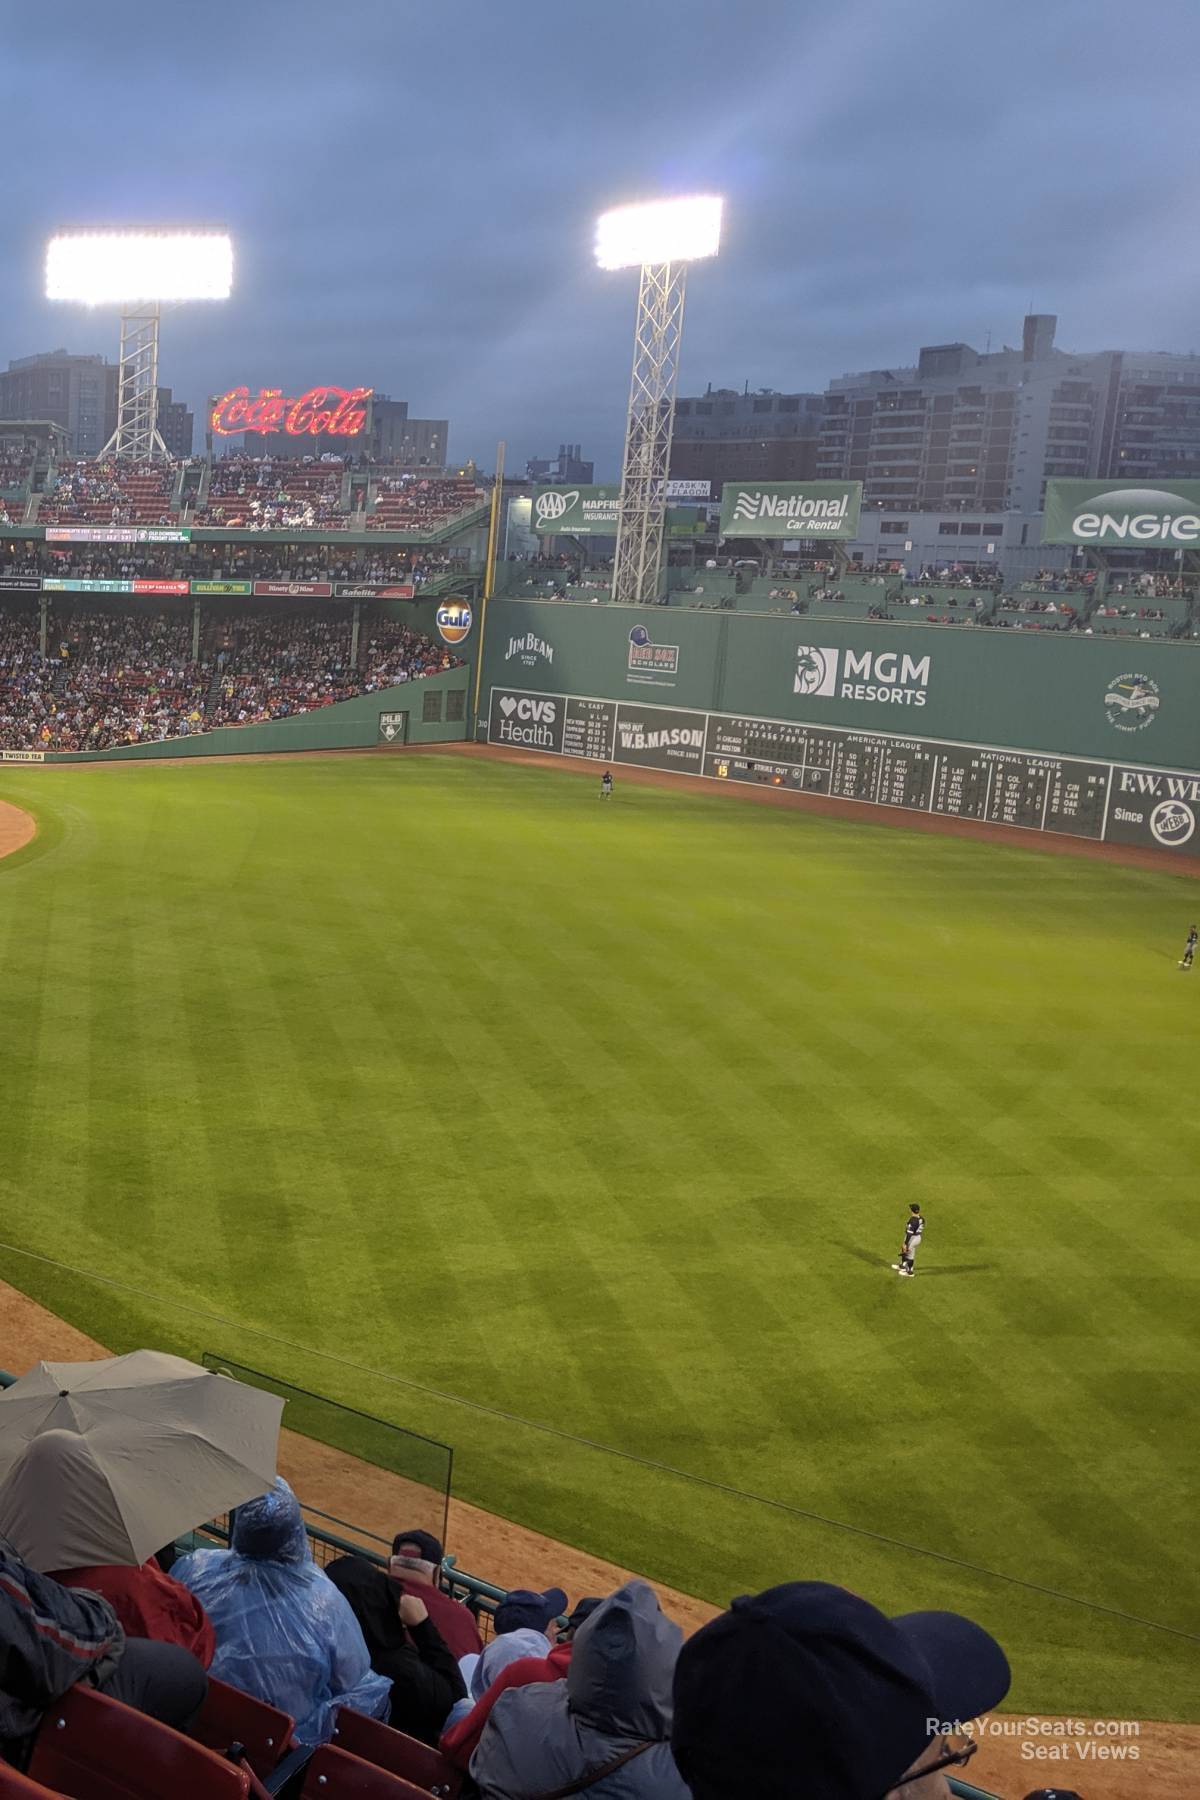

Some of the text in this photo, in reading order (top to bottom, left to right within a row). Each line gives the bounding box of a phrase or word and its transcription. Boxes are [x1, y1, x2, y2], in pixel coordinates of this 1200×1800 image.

[211, 384, 375, 436] Coca-Cola
[540, 493, 564, 517] AAA
[786, 519, 841, 530] Car Rental
[342, 587, 376, 596] Safelite
[438, 609, 471, 628] Gulf
[505, 632, 553, 664] JIM BEAM
[632, 659, 675, 668] SCHOLARS
[843, 649, 932, 686] MGM
[841, 683, 927, 707] RESORTS
[517, 698, 556, 723] CVS
[499, 719, 554, 746] Health
[731, 720, 808, 736] FENWAY PARK
[847, 735, 922, 751] AMERICAN LEAGUE
[667, 749, 684, 757] SINCE
[980, 752, 1062, 769] NATIONAL LEAGUE
[754, 764, 773, 772] STRIKE
[775, 765, 788, 774] OUT
[893, 781, 905, 789] MIN
[896, 774, 904, 782] TB
[1007, 775, 1021, 783] COL
[1120, 772, 1162, 796] F.W.
[948, 790, 962, 798] CHC
[1003, 806, 1016, 814] SEA
[1063, 807, 1077, 815] STL
[1114, 808, 1143, 823] Since
[1003, 814, 1014, 822] MIL
